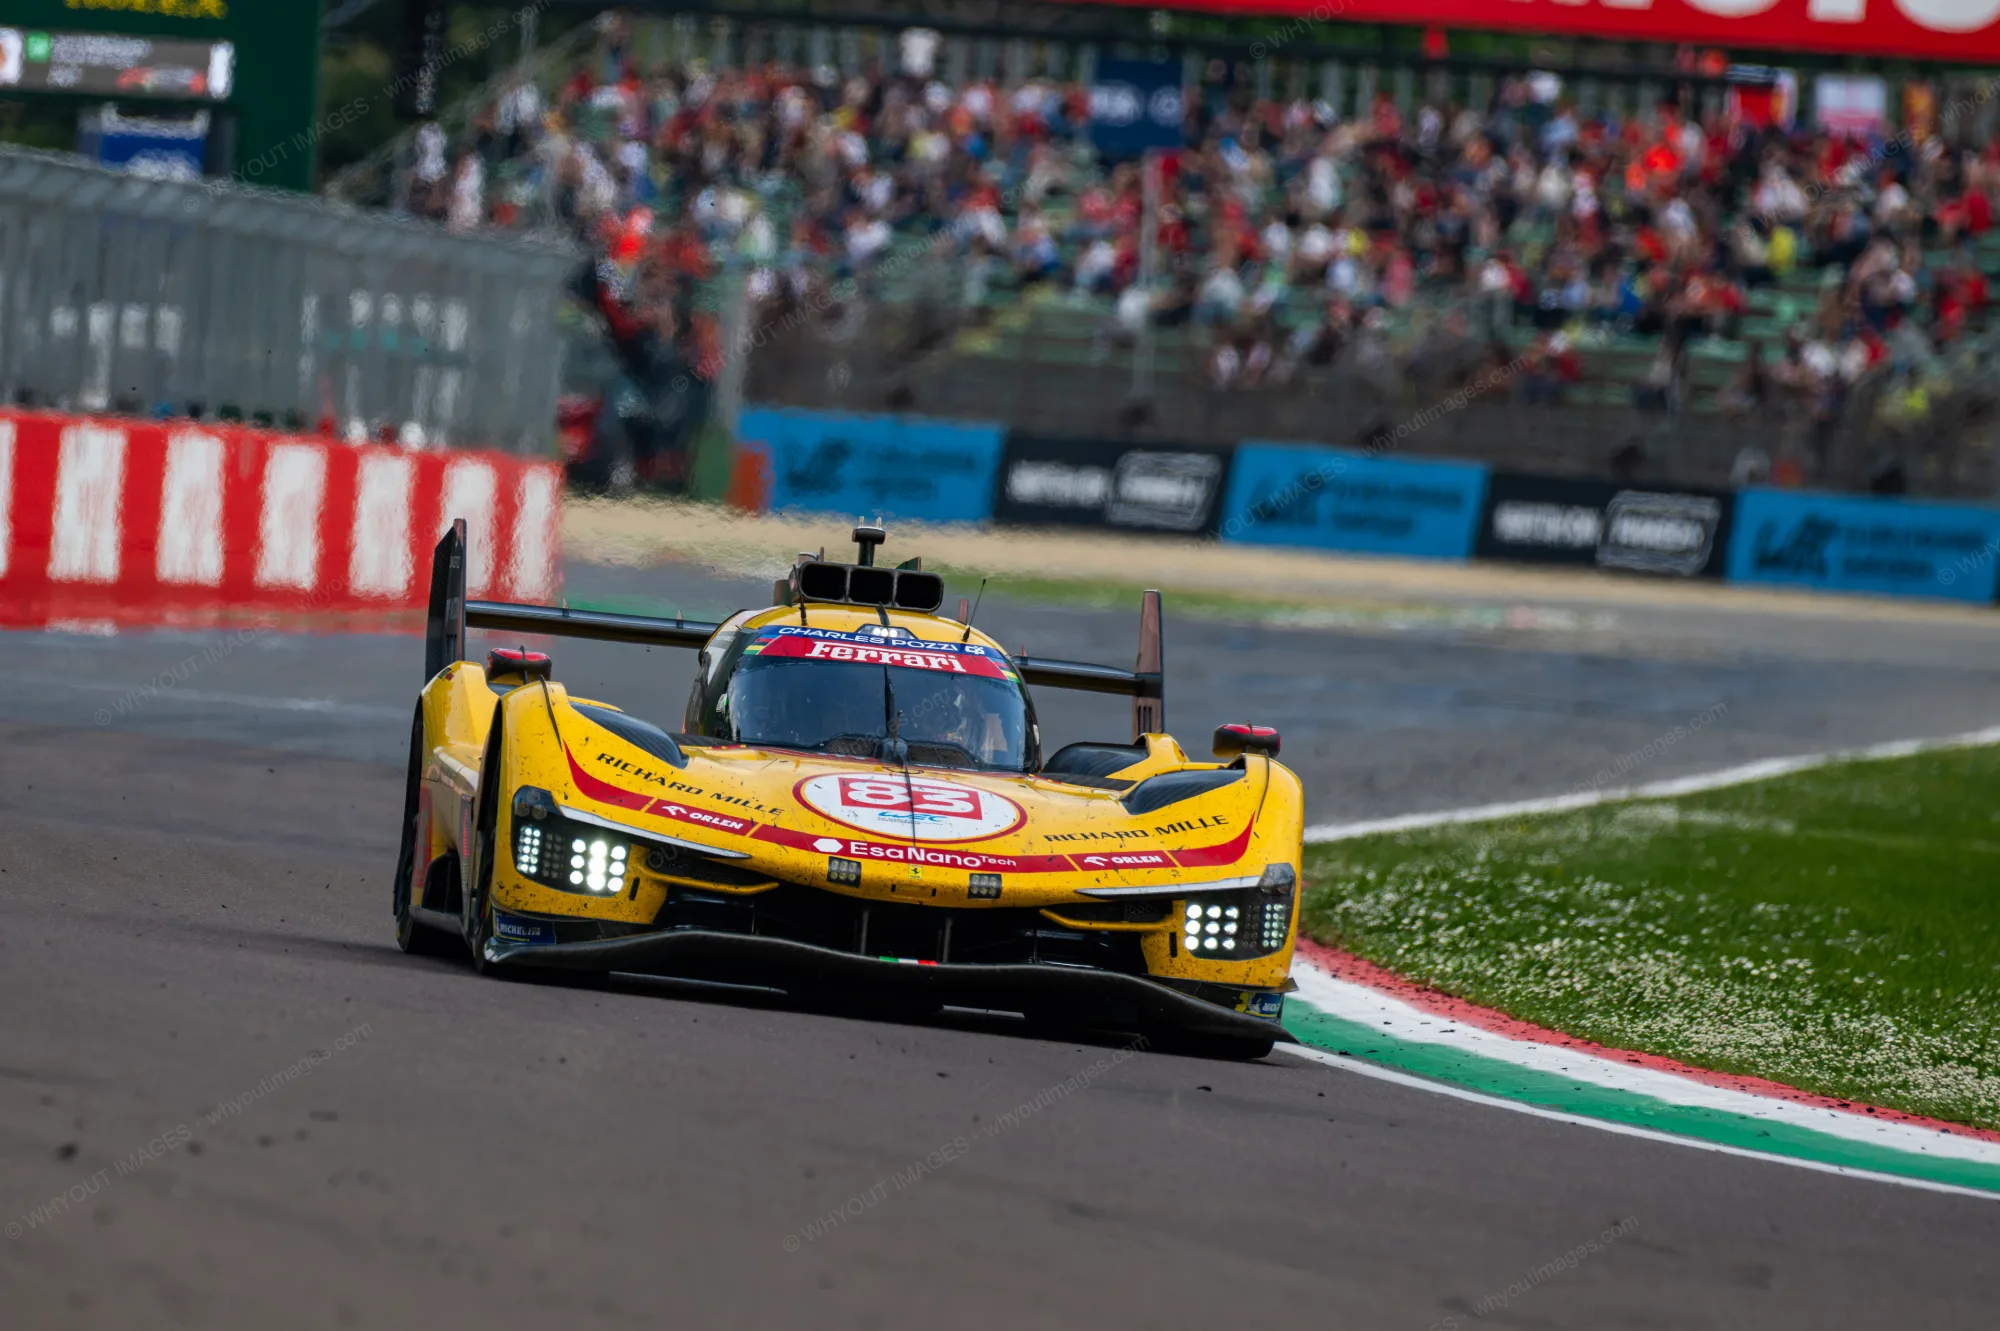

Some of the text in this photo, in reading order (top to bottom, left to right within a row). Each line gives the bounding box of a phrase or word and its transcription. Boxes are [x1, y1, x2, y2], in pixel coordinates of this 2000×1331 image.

[778, 627, 882, 644] CHARLES
[892, 639, 960, 651] POZZI
[805, 641, 967, 673] Ferrari
[596, 752, 786, 816] RICHARD MILLE
[848, 781, 975, 813] 83
[689, 811, 744, 830] ORLEN
[1043, 814, 1229, 842] RICHARD MILLE
[1111, 854, 1163, 865] ORLEN
